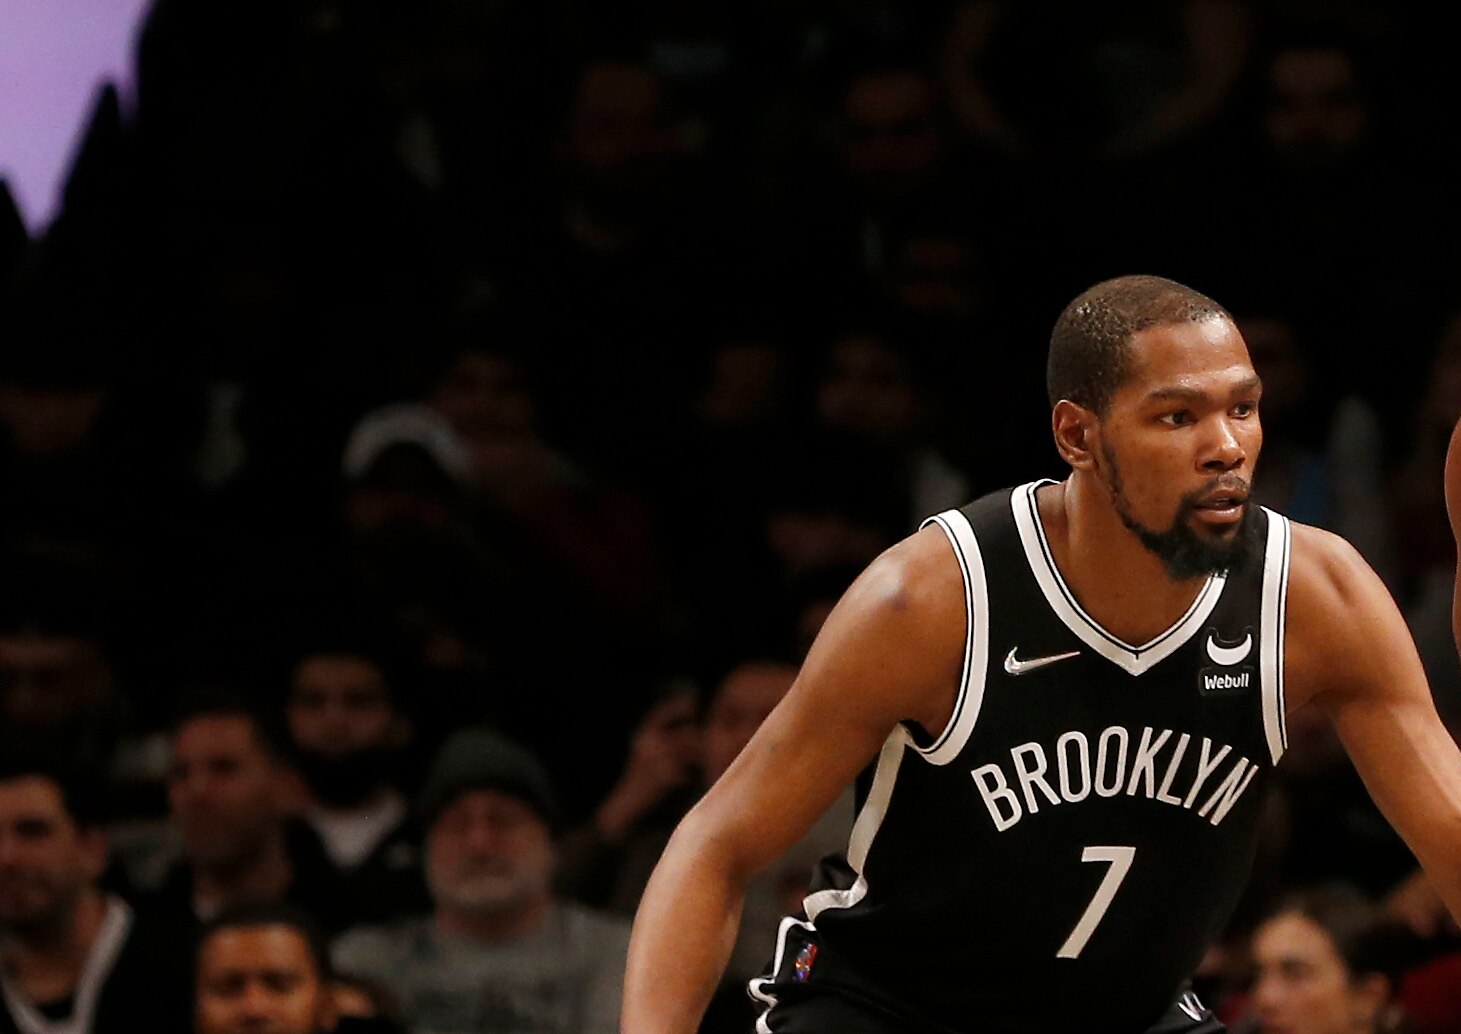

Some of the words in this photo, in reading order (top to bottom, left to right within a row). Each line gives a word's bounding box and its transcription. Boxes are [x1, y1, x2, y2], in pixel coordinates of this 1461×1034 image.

[1204, 672, 1250, 690] Webull
[970, 726, 1260, 832] BROOKLYN
[1055, 845, 1137, 959] 7
